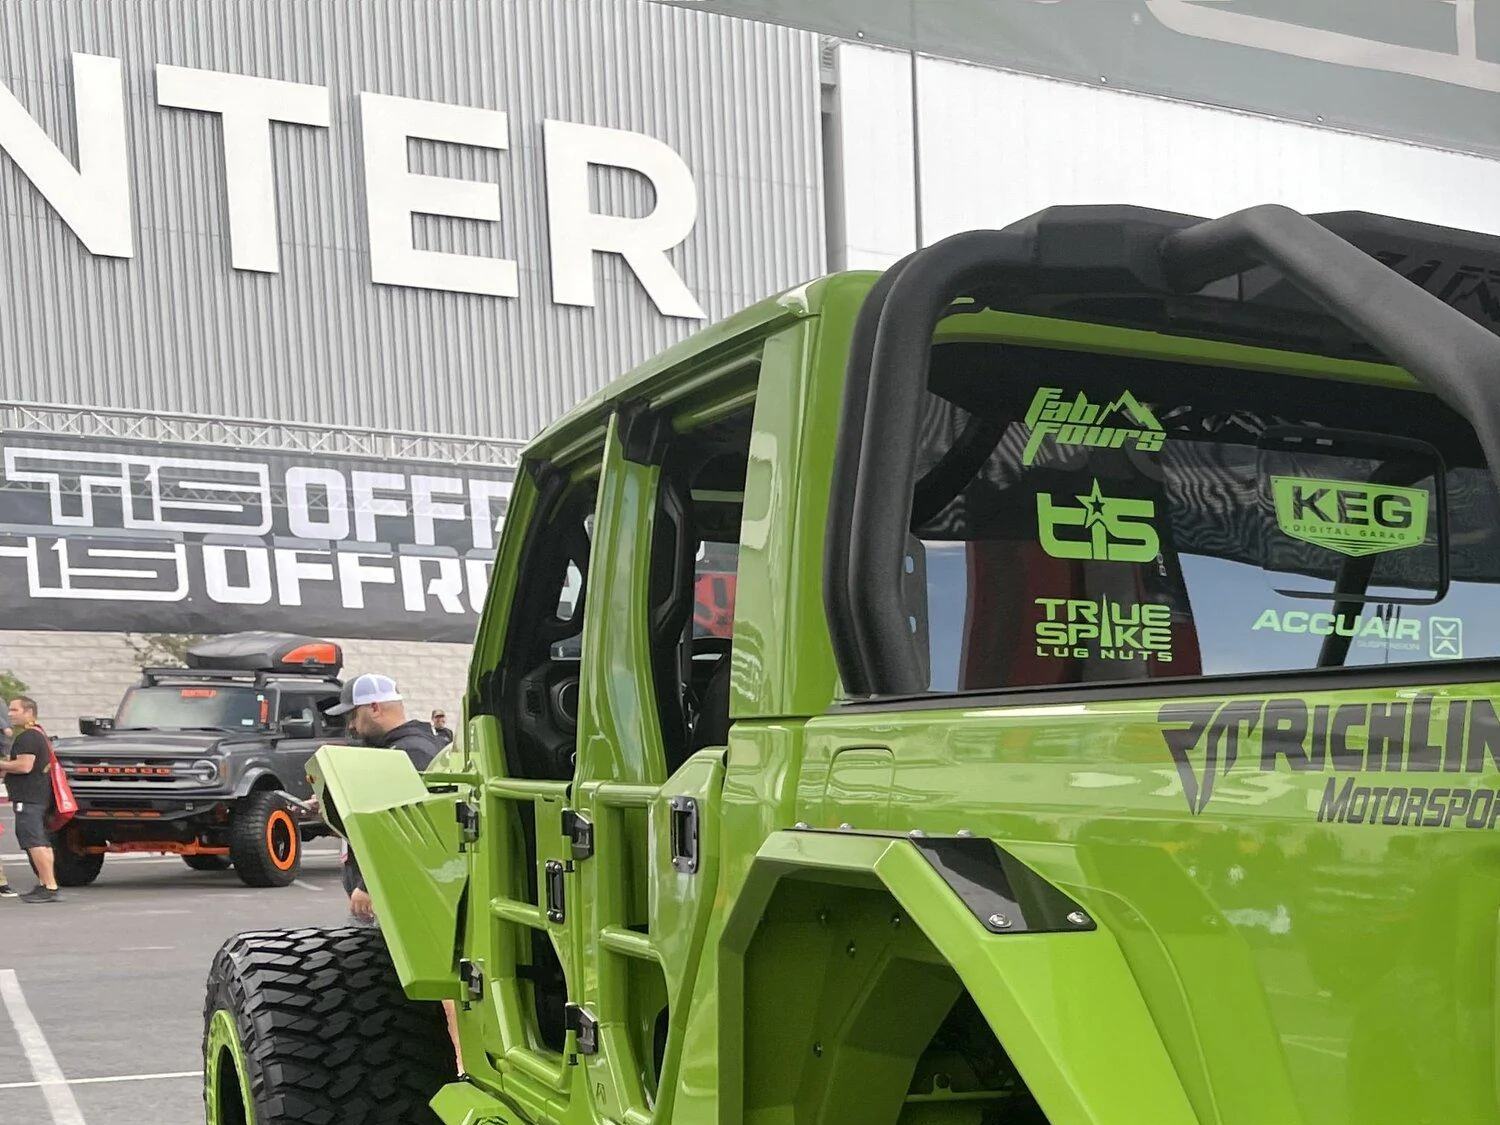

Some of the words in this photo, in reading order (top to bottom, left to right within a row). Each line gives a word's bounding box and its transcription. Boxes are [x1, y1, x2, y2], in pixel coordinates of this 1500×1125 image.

[4, 446, 271, 536] TIS
[1292, 486, 1412, 529] KEG
[1292, 524, 1351, 536] DIGITAL
[0, 535, 189, 602] IS
[1035, 597, 1172, 627] TRUE
[1251, 608, 1422, 641] ACCUAIR
[1035, 618, 1172, 651] SPIKE
[1036, 646, 1089, 658] LUG
[1100, 648, 1173, 663] NUTS
